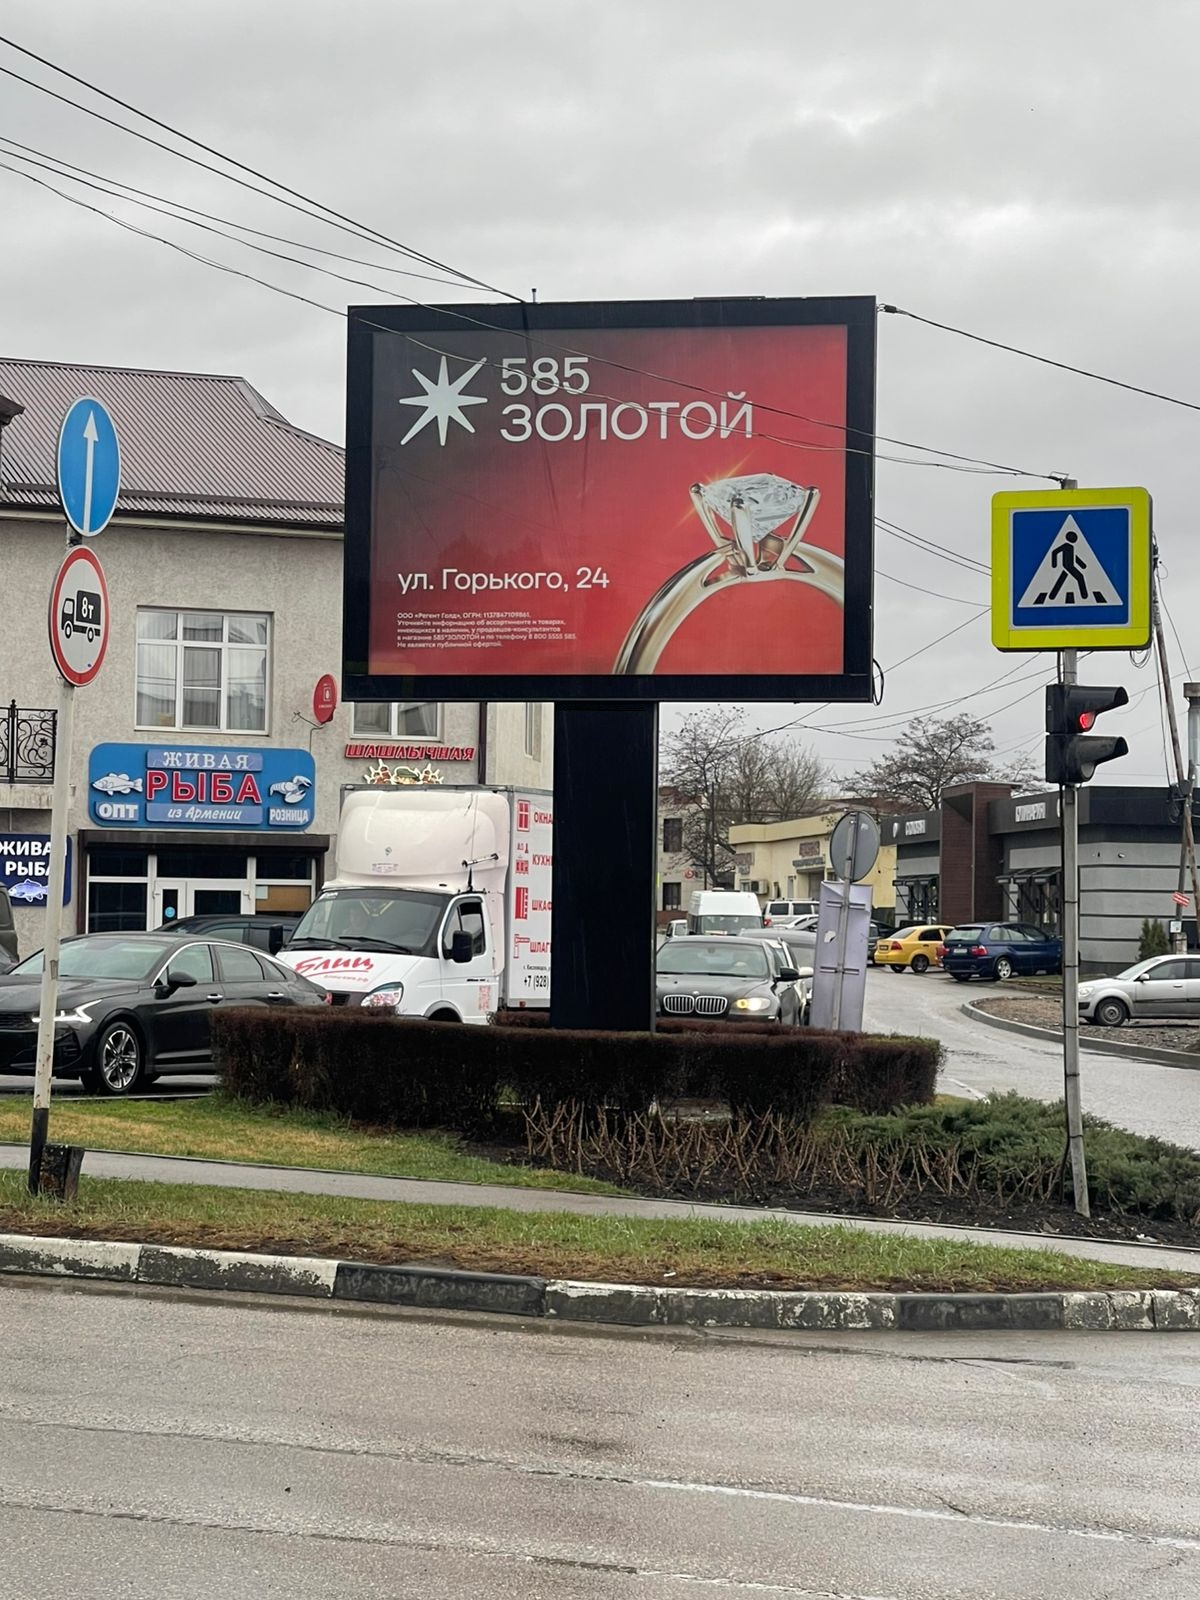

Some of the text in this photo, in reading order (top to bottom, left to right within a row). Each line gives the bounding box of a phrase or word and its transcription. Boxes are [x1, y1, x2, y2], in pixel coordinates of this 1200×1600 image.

[500, 357, 589, 396] 585
[500, 391, 753, 442] ЗОЛОТОЙ
[398, 566, 610, 595] ул. Горького, 24
[162, 751, 249, 769] ЖИВАЯ
[345, 743, 476, 761] ШАШЛЫЧНАЯ
[146, 770, 263, 804] РЫБА
[98, 803, 139, 819] ОПТ
[167, 806, 243, 820] из Армении
[269, 807, 310, 824] РОЗНИЦА
[0, 840, 66, 856] ЖИВА
[532, 853, 553, 868] КУХН
